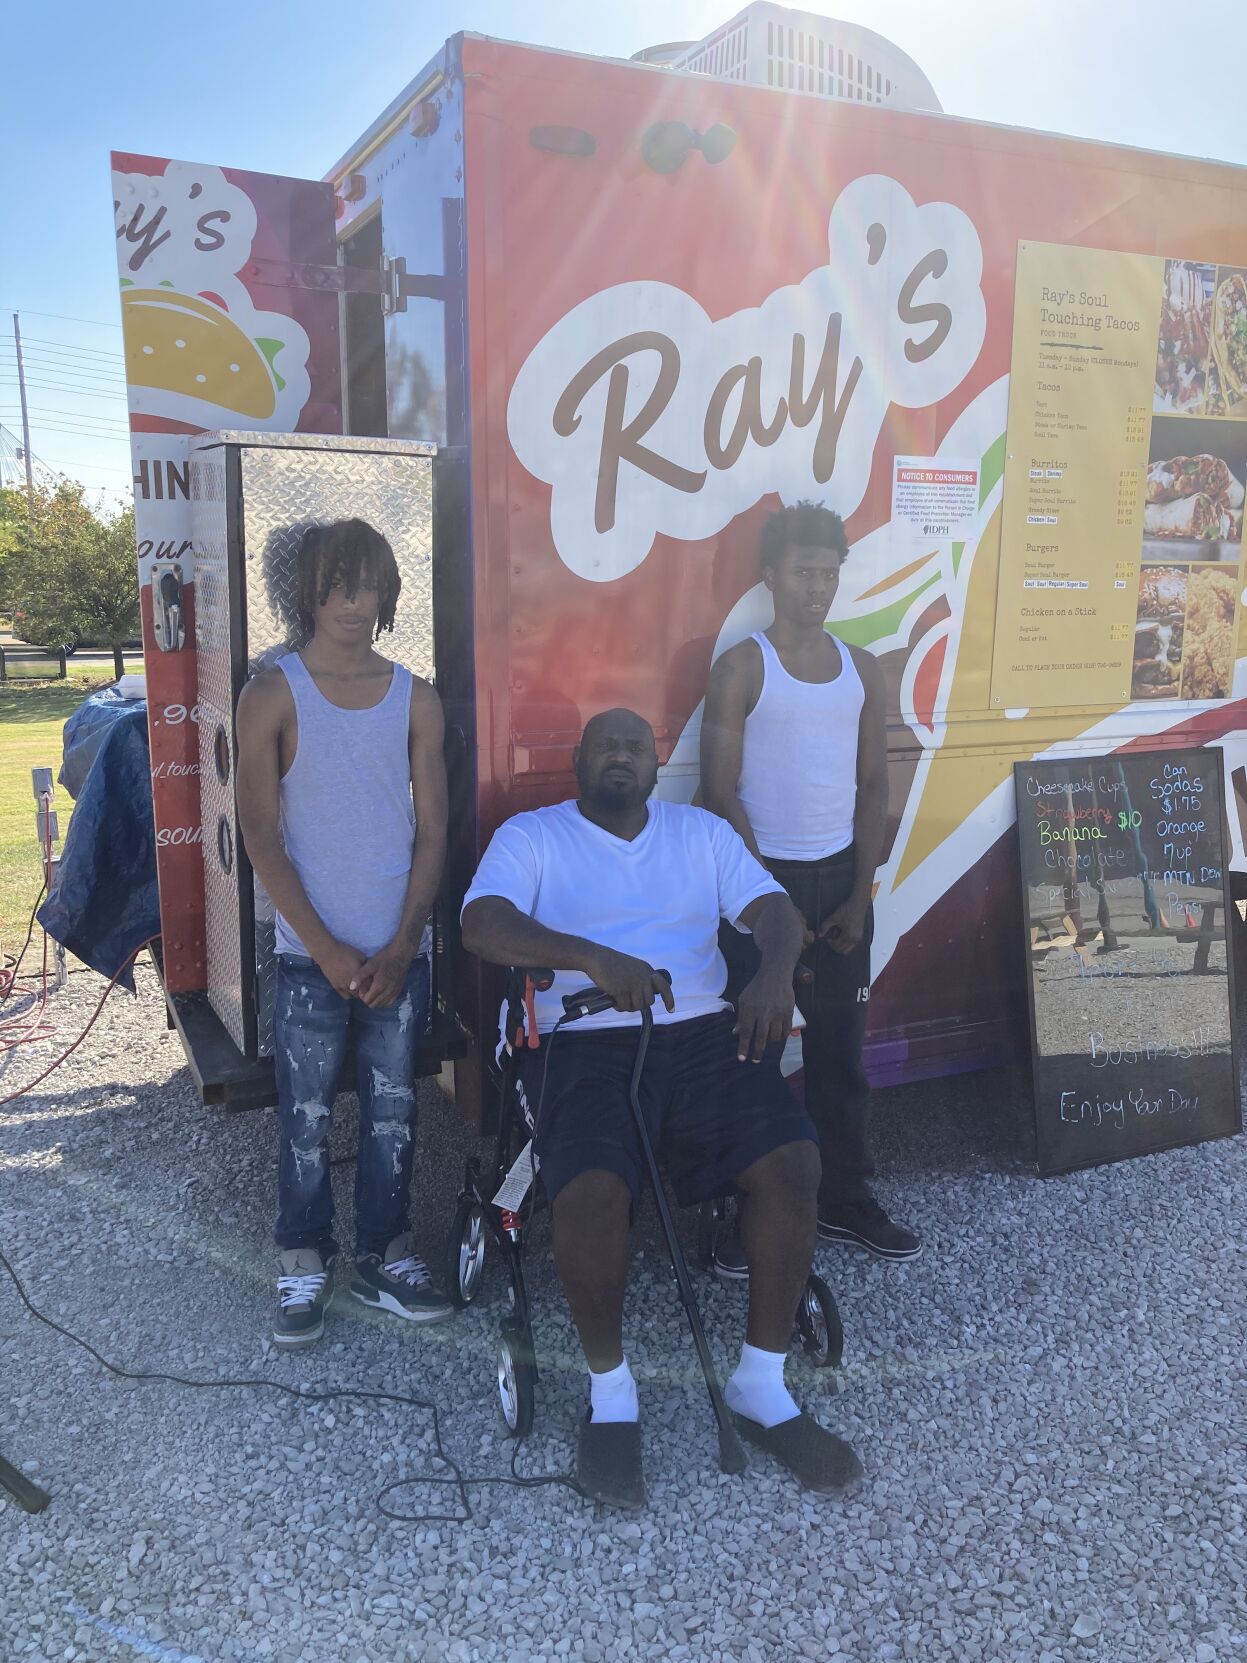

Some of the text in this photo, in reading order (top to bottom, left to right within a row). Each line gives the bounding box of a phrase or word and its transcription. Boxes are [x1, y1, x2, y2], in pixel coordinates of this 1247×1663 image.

[1041, 288, 1109, 307] Ray's Soul
[1040, 309, 1140, 331] Touching Tacos
[552, 222, 952, 534] Ray's
[1037, 381, 1061, 392] Tacos
[1031, 459, 1068, 469] Burritos
[902, 472, 925, 480] NOTICE
[934, 473, 973, 482] CONSUMERS
[929, 526, 949, 534] IDPH
[1026, 543, 1059, 553] Burgers
[1020, 608, 1053, 616] Chicken
[1074, 608, 1096, 616] Stick
[1163, 764, 1187, 779] Can
[1026, 776, 1094, 797] Cheesecake
[1150, 775, 1204, 799] Sodas
[1036, 800, 1113, 825] Strawberry
[1161, 796, 1201, 816] $1.75
[1117, 810, 1142, 831] $10
[1037, 820, 1108, 846] Banana
[1156, 820, 1208, 843] Orange
[1044, 847, 1129, 870] Chocolate
[1163, 870, 1195, 886] MTN
[856, 986, 871, 1002] 19
[1060, 1091, 1125, 1129] Enjoy
[1128, 1088, 1162, 1116] Your
